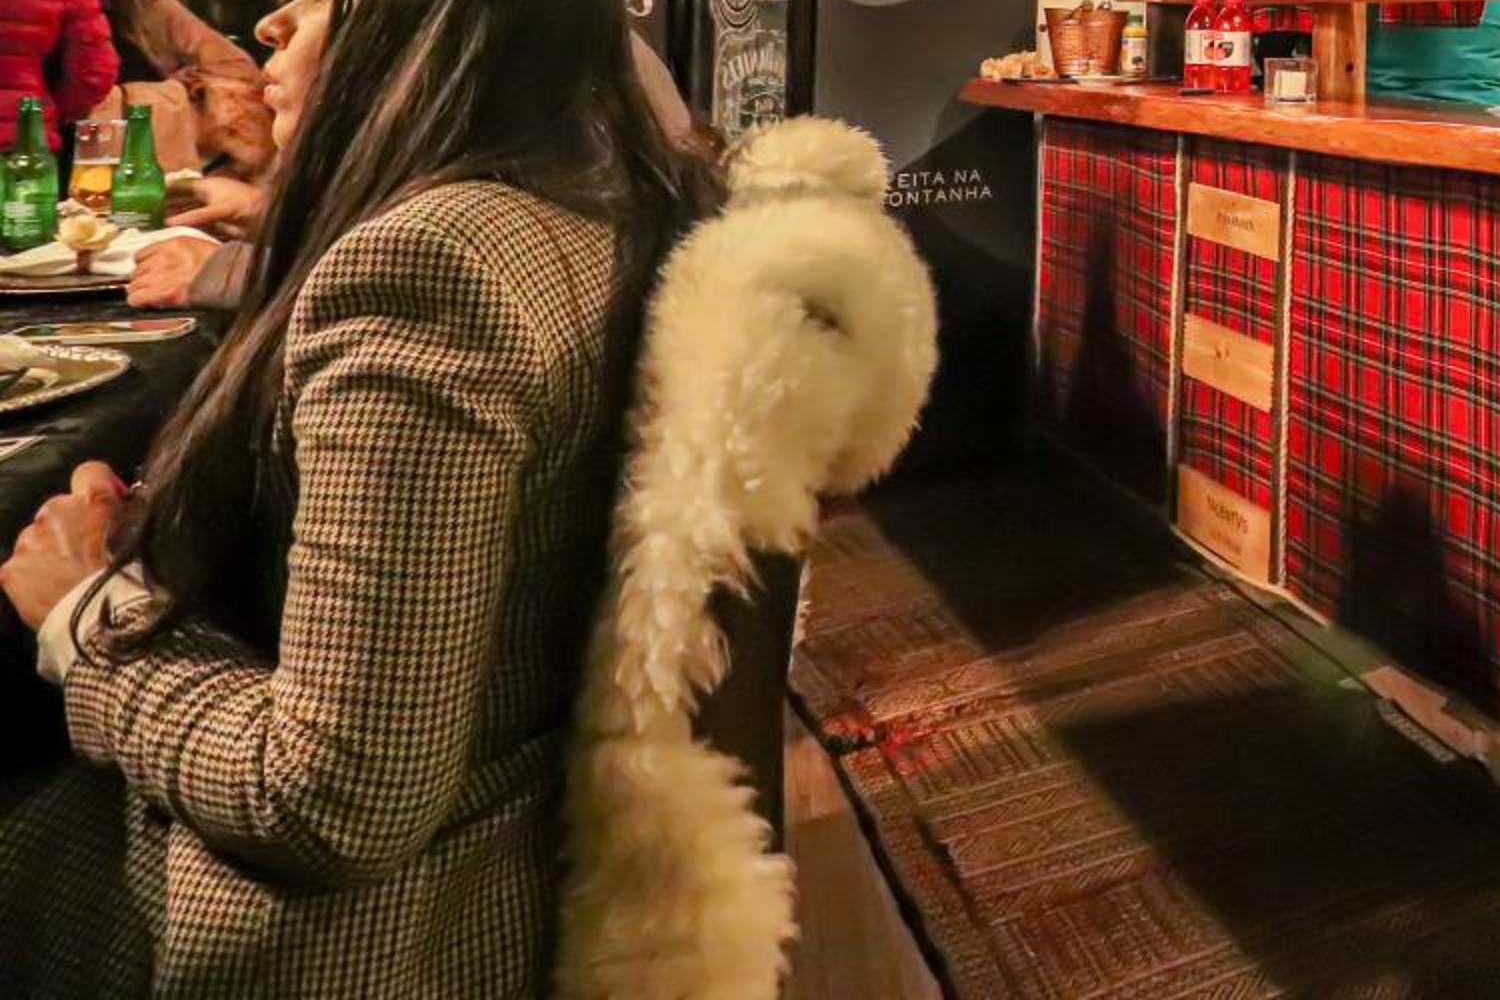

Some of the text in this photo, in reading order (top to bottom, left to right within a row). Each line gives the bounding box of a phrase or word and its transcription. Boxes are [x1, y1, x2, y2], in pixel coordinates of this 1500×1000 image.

[897, 168, 981, 189] EITA NA
[888, 184, 993, 207] ONTANHA
